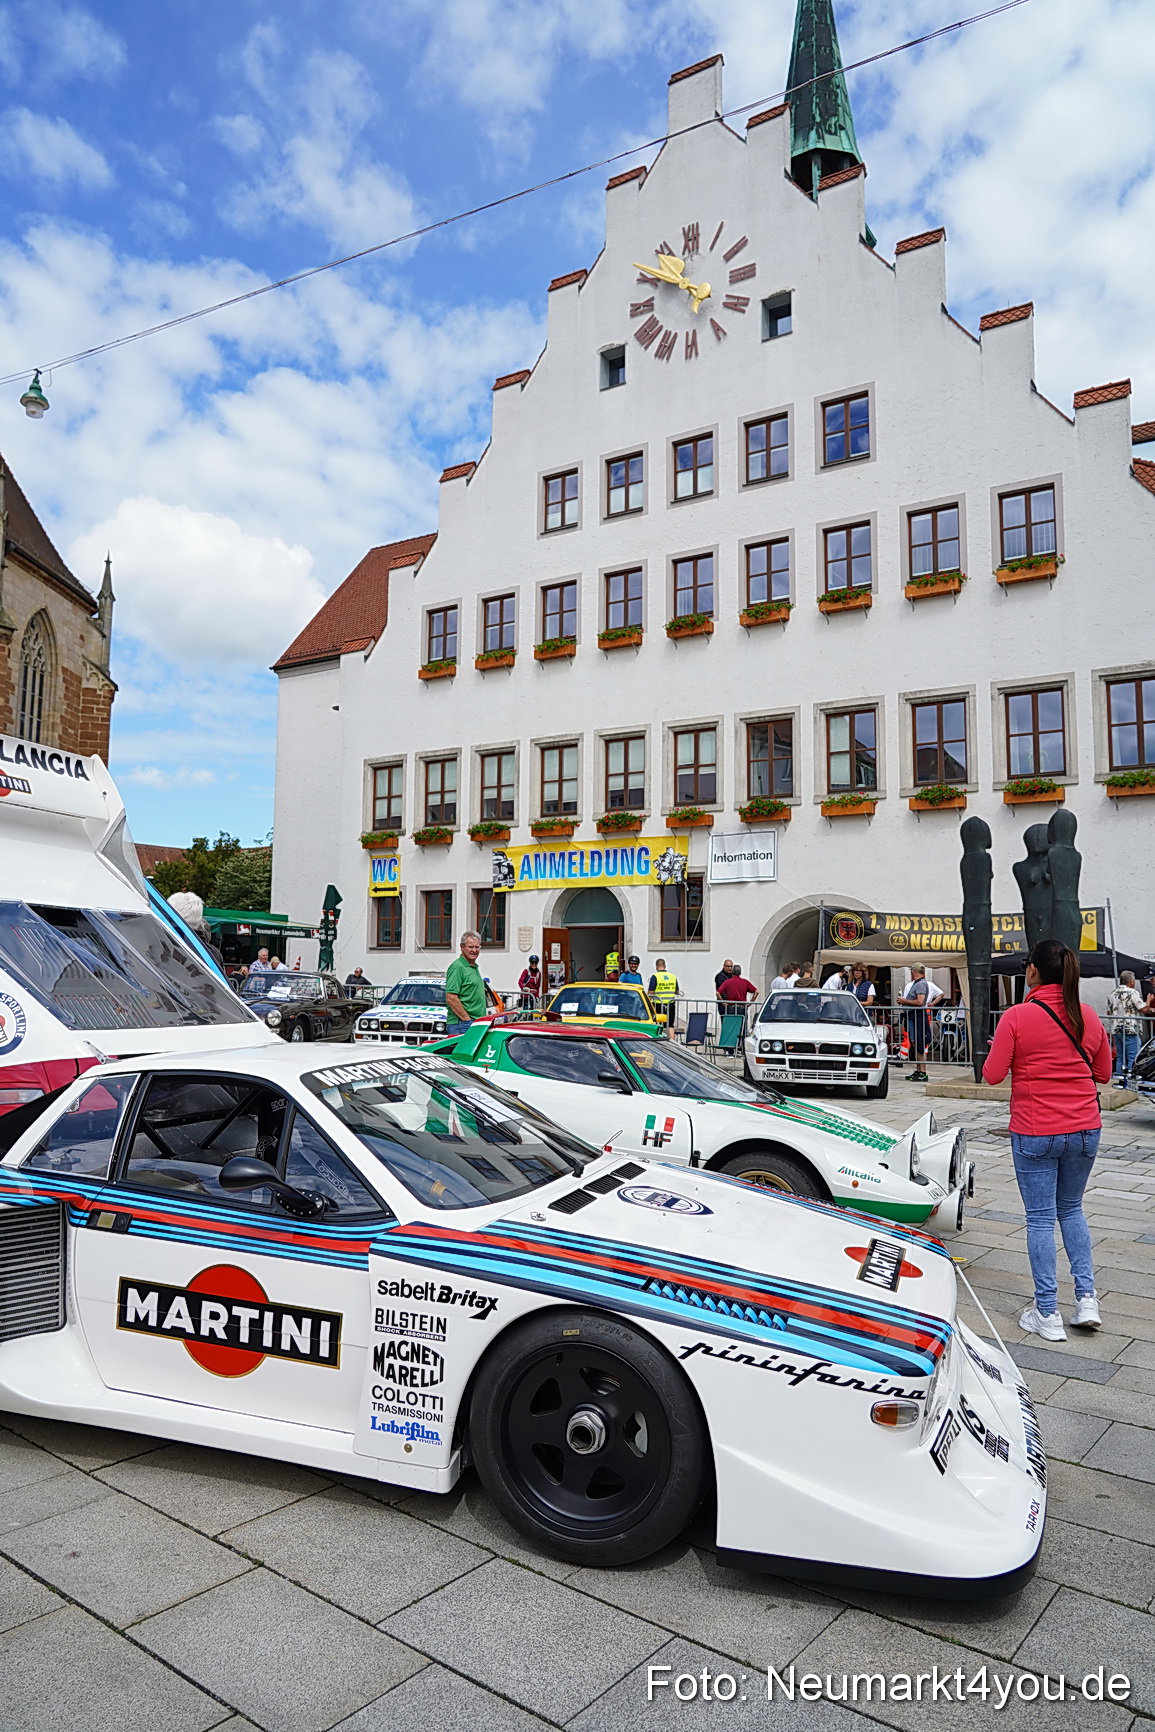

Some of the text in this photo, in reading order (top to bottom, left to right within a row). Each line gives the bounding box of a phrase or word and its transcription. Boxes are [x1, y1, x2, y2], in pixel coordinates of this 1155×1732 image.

[0, 739, 91, 782] LANCIA
[519, 846, 650, 881] ANMELDUNG
[713, 850, 773, 863] Information
[371, 857, 398, 882] WC
[869, 914, 881, 929] 1.
[1005, 942, 1022, 951] e.V.
[1, 994, 26, 1039] SPORTLINE
[944, 1011, 953, 1022] 6
[312, 1062, 402, 1087] MARTINI
[763, 1071, 776, 1080] NM
[778, 1072, 790, 1080] KX
[642, 1130, 673, 1148] HF
[837, 1166, 881, 1184] Alitalia
[864, 1240, 900, 1288] MARTINI
[377, 1278, 499, 1320] sabelt Britax
[125, 1287, 331, 1358] MARTINI
[375, 1307, 447, 1335] BILSTEIN
[376, 1326, 444, 1341] SHOCK ABSORBERS
[373, 1340, 444, 1366] MAGNETI
[373, 1361, 444, 1388] MARELLI
[678, 1342, 927, 1400] pininfarina
[371, 1385, 444, 1411] COLOTTI
[371, 1402, 443, 1423] TRASMISSIONI
[370, 1416, 441, 1441] Lubrifilm
[929, 1408, 962, 1476] PIRELLI
